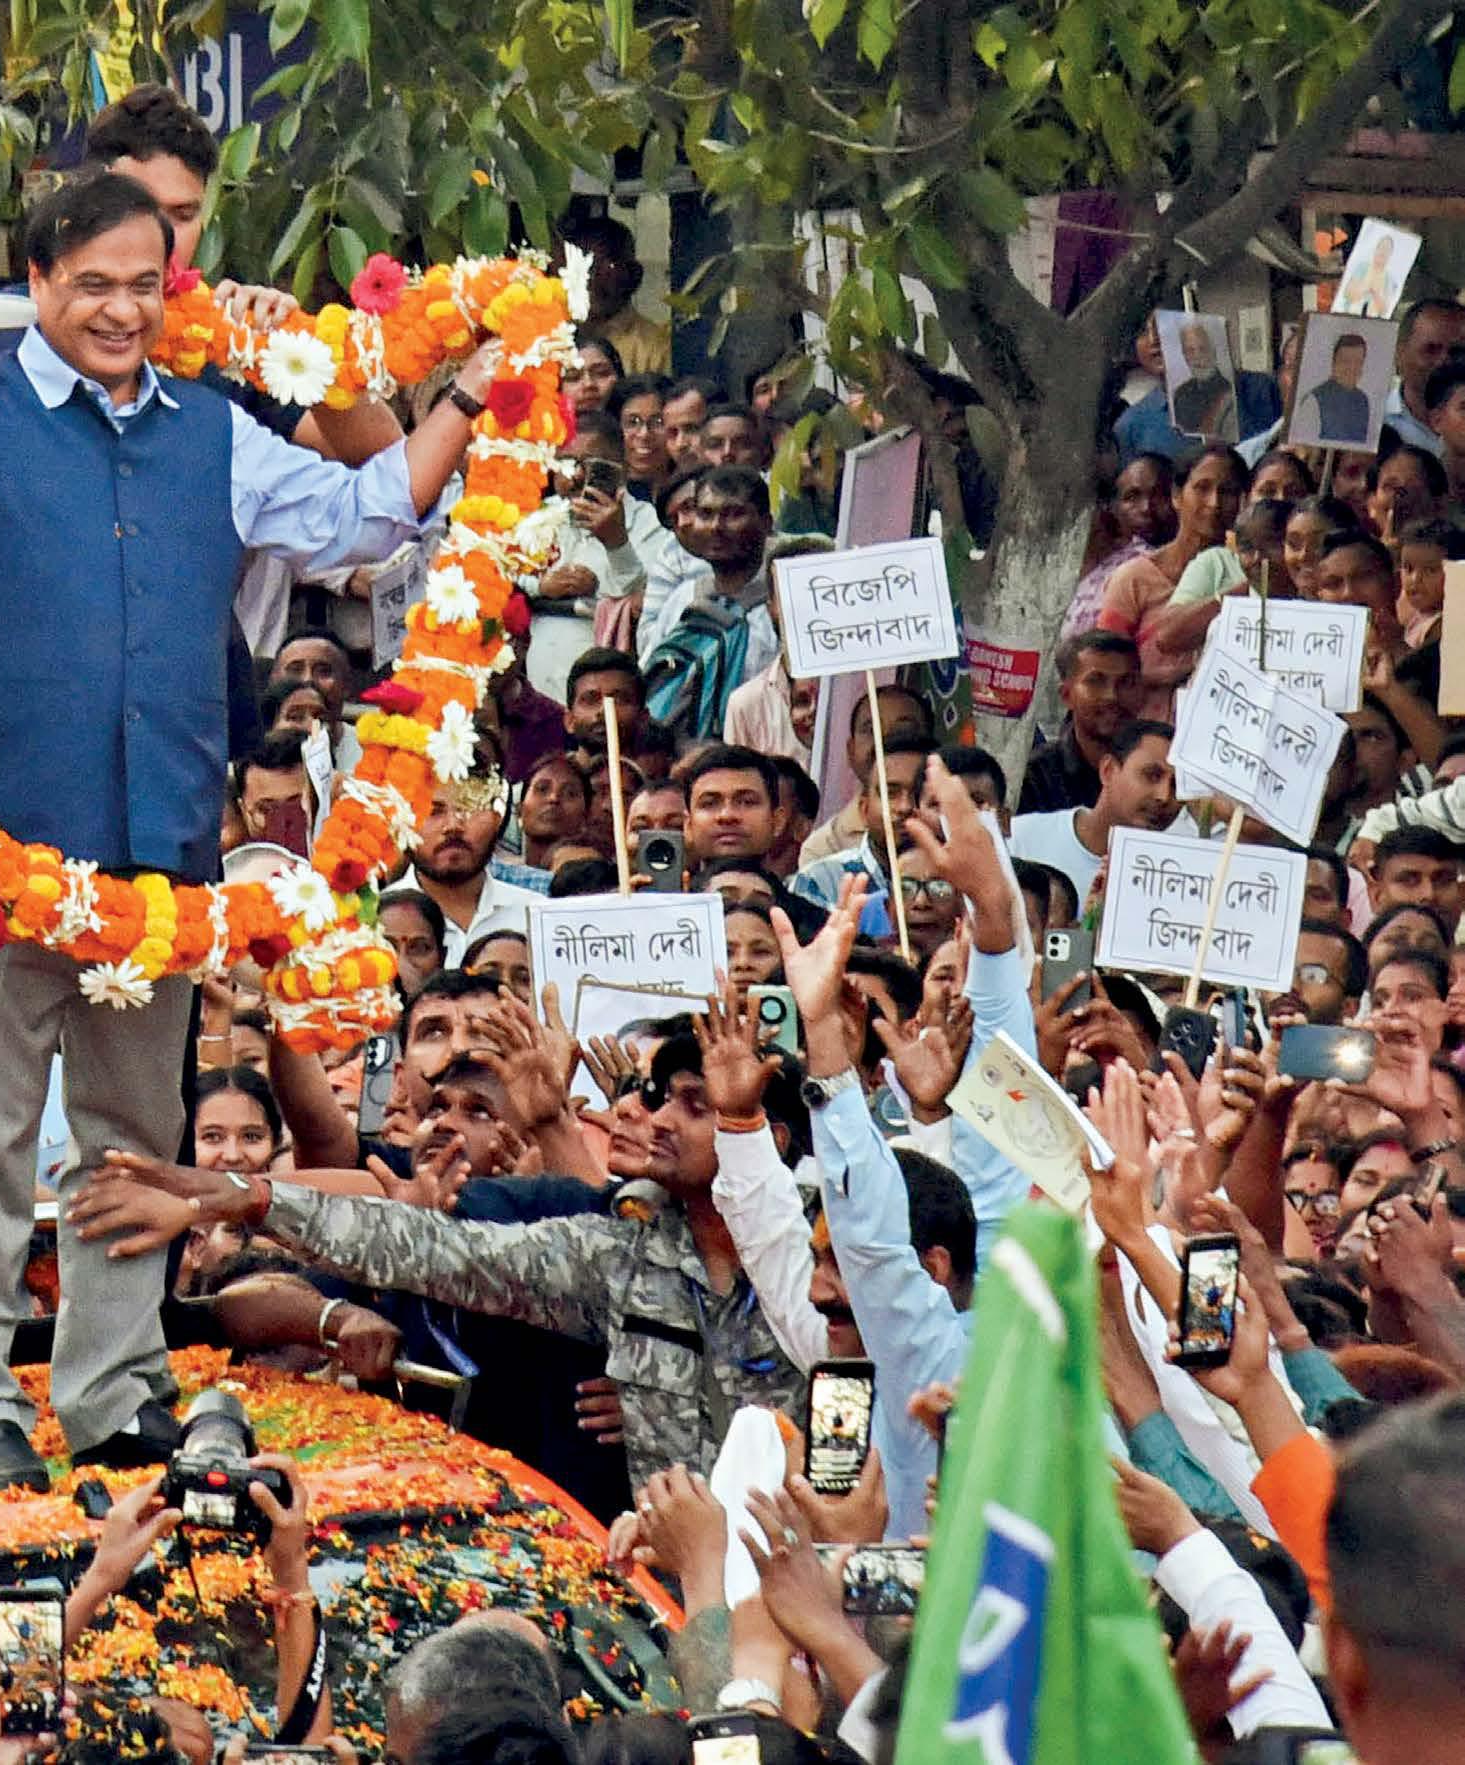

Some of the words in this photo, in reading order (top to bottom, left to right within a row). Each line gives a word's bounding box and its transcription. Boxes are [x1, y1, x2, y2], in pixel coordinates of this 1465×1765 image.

[183, 33, 243, 135] BI
[808, 565, 918, 612] বিজেপি
[806, 614, 931, 655] জিন্দাবাদ
[1131, 854, 1215, 904] নীলিমা
[552, 924, 636, 966] নীলিমা
[1147, 907, 1254, 961] জিন্দবাদ
